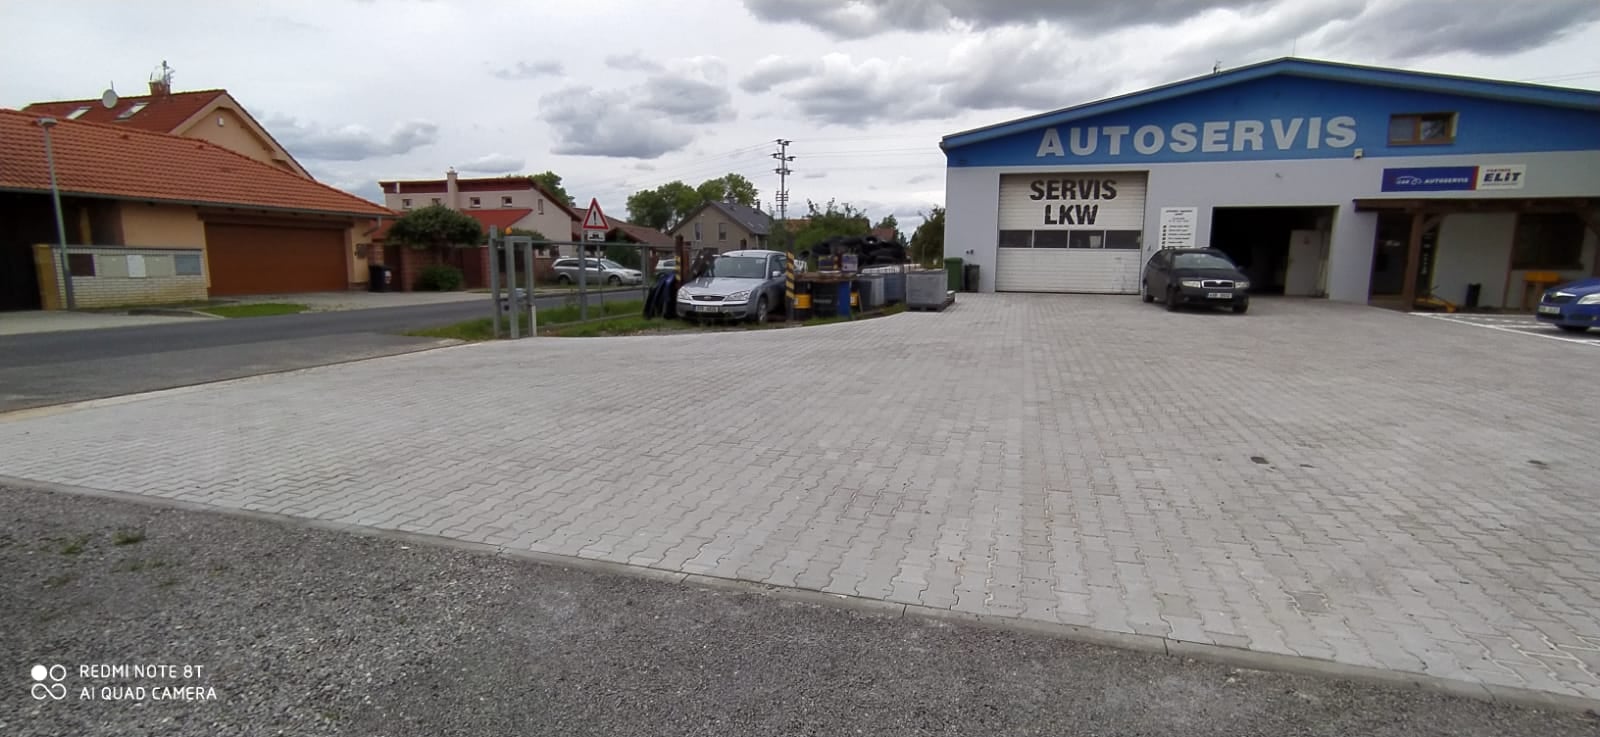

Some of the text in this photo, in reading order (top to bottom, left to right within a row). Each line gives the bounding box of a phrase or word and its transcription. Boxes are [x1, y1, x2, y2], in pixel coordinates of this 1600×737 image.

[1036, 115, 1357, 158] AUTOSERVIS
[1029, 179, 1118, 200] SERVIS
[1044, 204, 1098, 225] LKW
